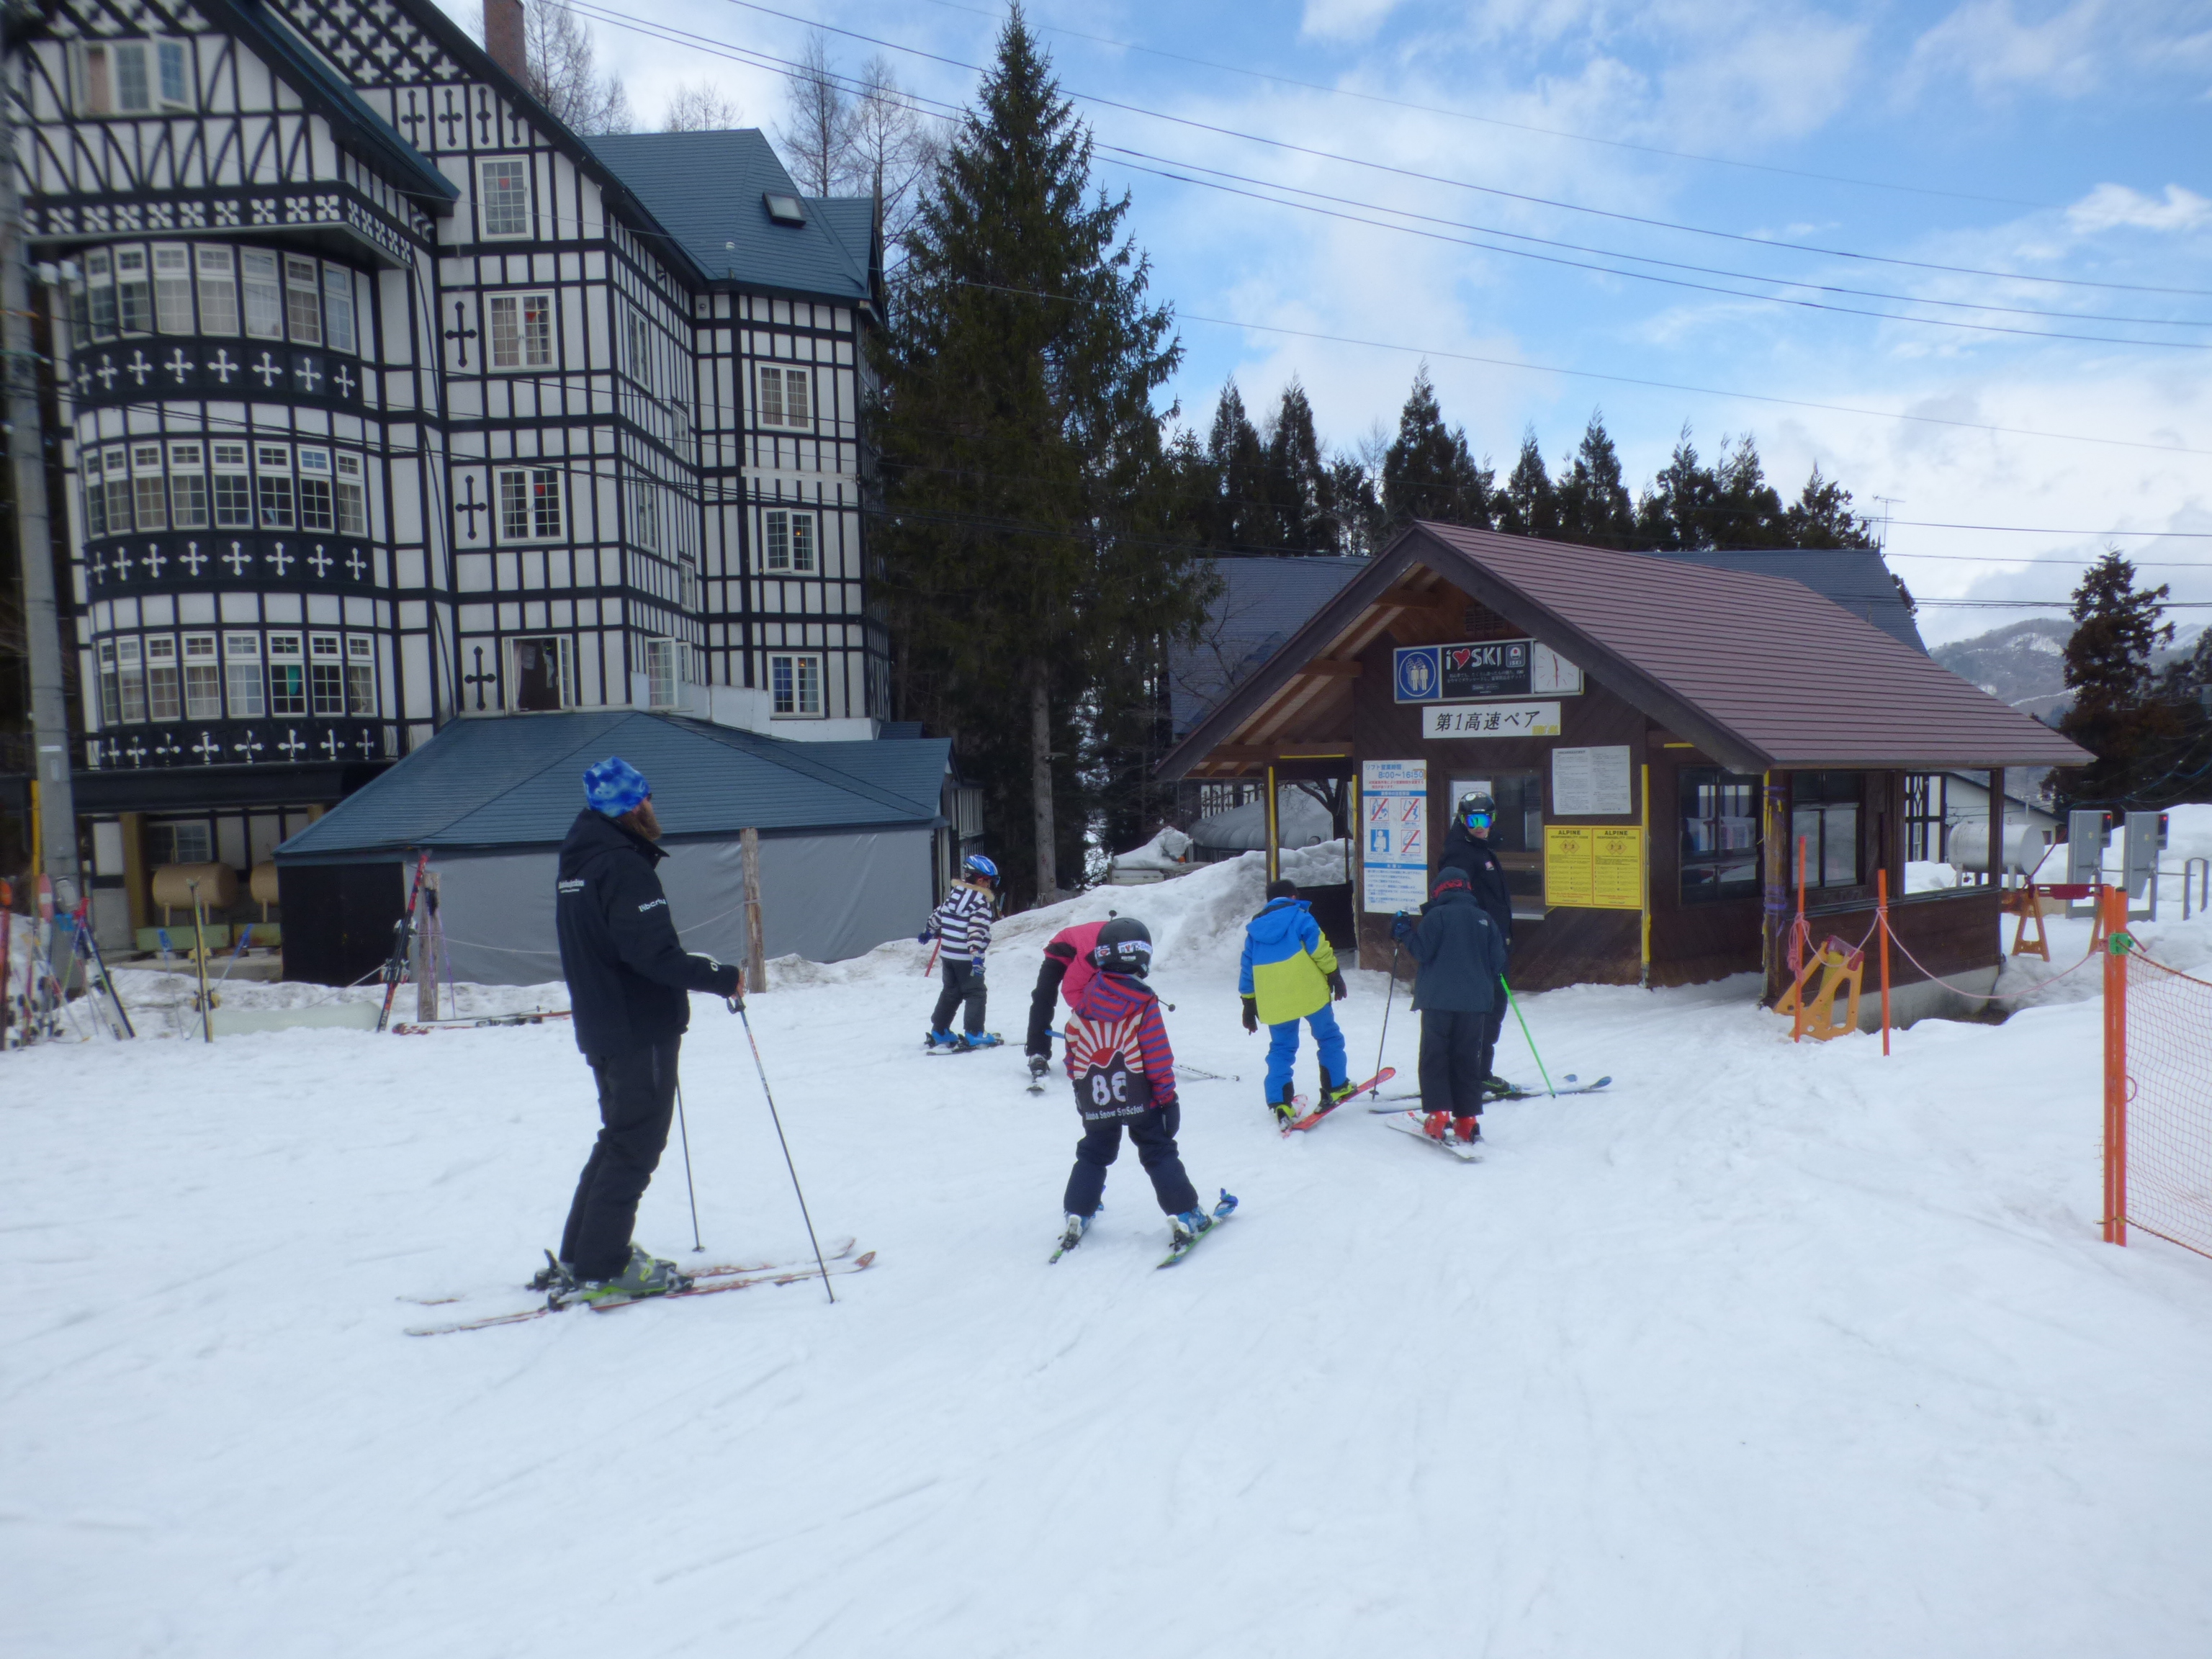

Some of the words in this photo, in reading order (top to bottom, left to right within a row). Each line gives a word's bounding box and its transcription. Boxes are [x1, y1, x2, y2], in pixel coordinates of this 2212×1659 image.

[1471, 646, 1502, 667] SKI
[1434, 710, 1540, 732] 第1高速ペア
[1100, 1110, 1116, 1119] Snow
